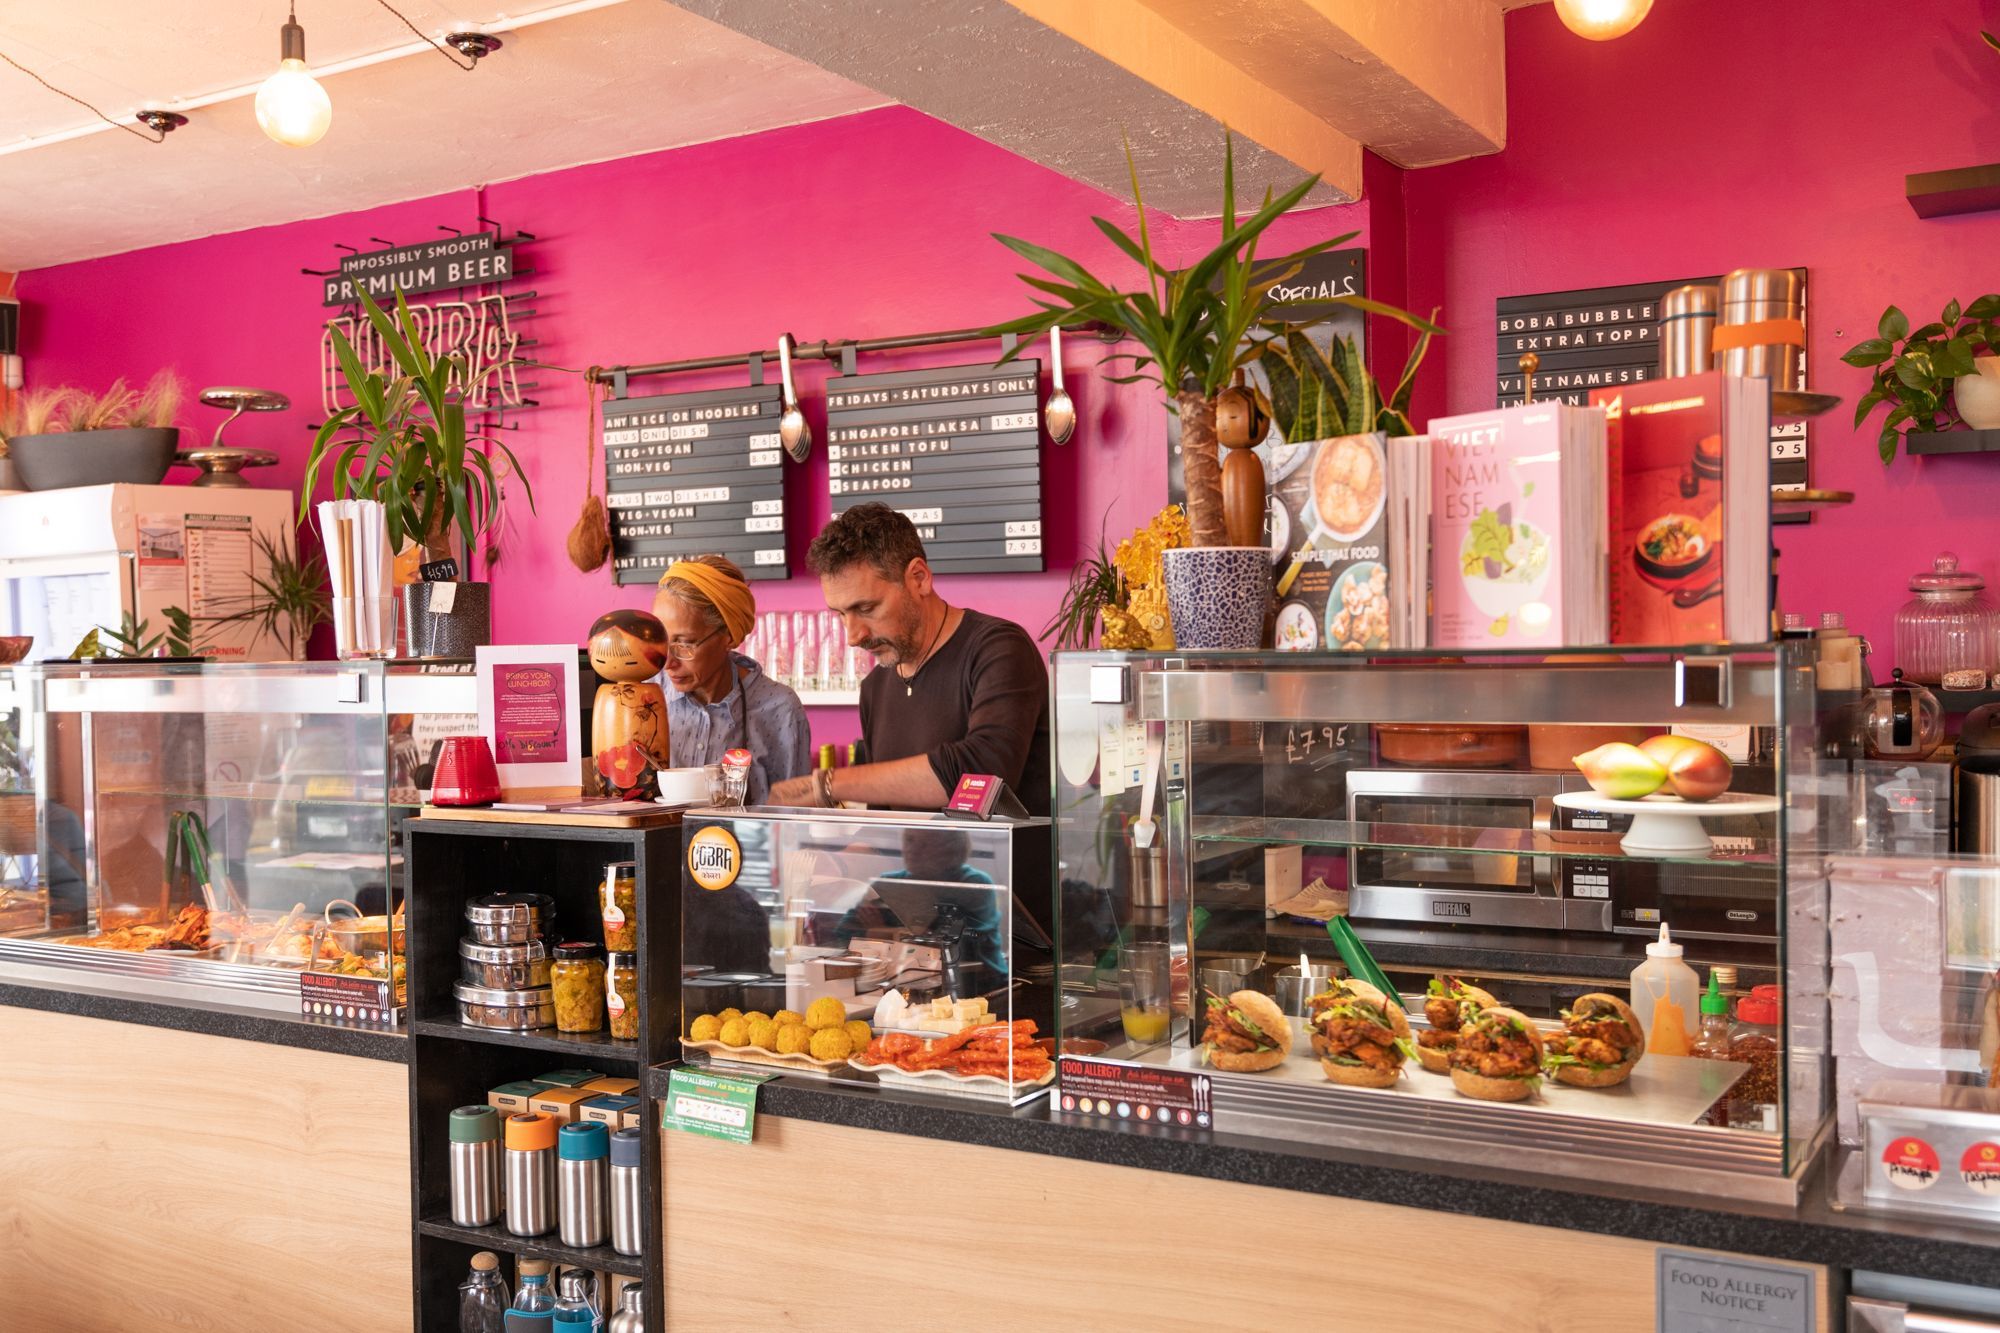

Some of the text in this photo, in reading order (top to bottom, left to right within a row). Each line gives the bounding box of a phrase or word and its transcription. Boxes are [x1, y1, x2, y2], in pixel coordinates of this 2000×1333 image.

[343, 237, 490, 273] IMPOSSIBLY SMOOTH
[326, 254, 509, 302] PREMIUM BEER
[1267, 276, 1356, 302] SPECIALS
[1500, 306, 1651, 331] BOBA BUBBLE
[1516, 334, 1585, 350] EXTRA
[1499, 369, 1644, 391] VIETNAMESE
[828, 392, 888, 407] FRIDAYS
[902, 380, 991, 401] SATURDAYS
[998, 379, 1036, 392] ONLY
[606, 403, 760, 429] ANY RICE OR NOODLES
[605, 425, 708, 444] PLUS ONE DISH
[829, 415, 1035, 442] SINGAPORE LAKSA 13.95
[614, 448, 639, 459] VEG
[648, 443, 691, 456] VEGAN
[841, 440, 950, 457] SILKEN TOFU
[1440, 428, 1500, 459] VIET
[616, 461, 671, 473] NON-VEG
[841, 460, 911, 475] CHICKEN
[842, 478, 912, 492] SEAFOOD
[1445, 464, 1499, 490] NAM
[609, 489, 728, 506] PLUS TWO DISHES
[1445, 491, 1484, 519] ESE
[618, 510, 643, 521] VEG
[652, 506, 694, 519] VEGAN
[620, 524, 672, 537] NON-VEG
[1007, 523, 1038, 534] 6.45
[1007, 541, 1038, 552] 7.95
[1327, 547, 1350, 561] THAI
[1350, 546, 1380, 560] FOOD
[614, 557, 636, 569] ANY
[505, 672, 552, 680] BRING YOUR
[691, 844, 732, 873] COBRA
[1062, 1061, 1082, 1074] FOOD
[1084, 1064, 1121, 1079] ALLERGY?
[671, 1073, 688, 1082] FOOD
[688, 1076, 717, 1088] ALLERGY?
[1671, 1269, 1798, 1301] FOOD ALLERGY
[1700, 1290, 1767, 1313] NOTICE
